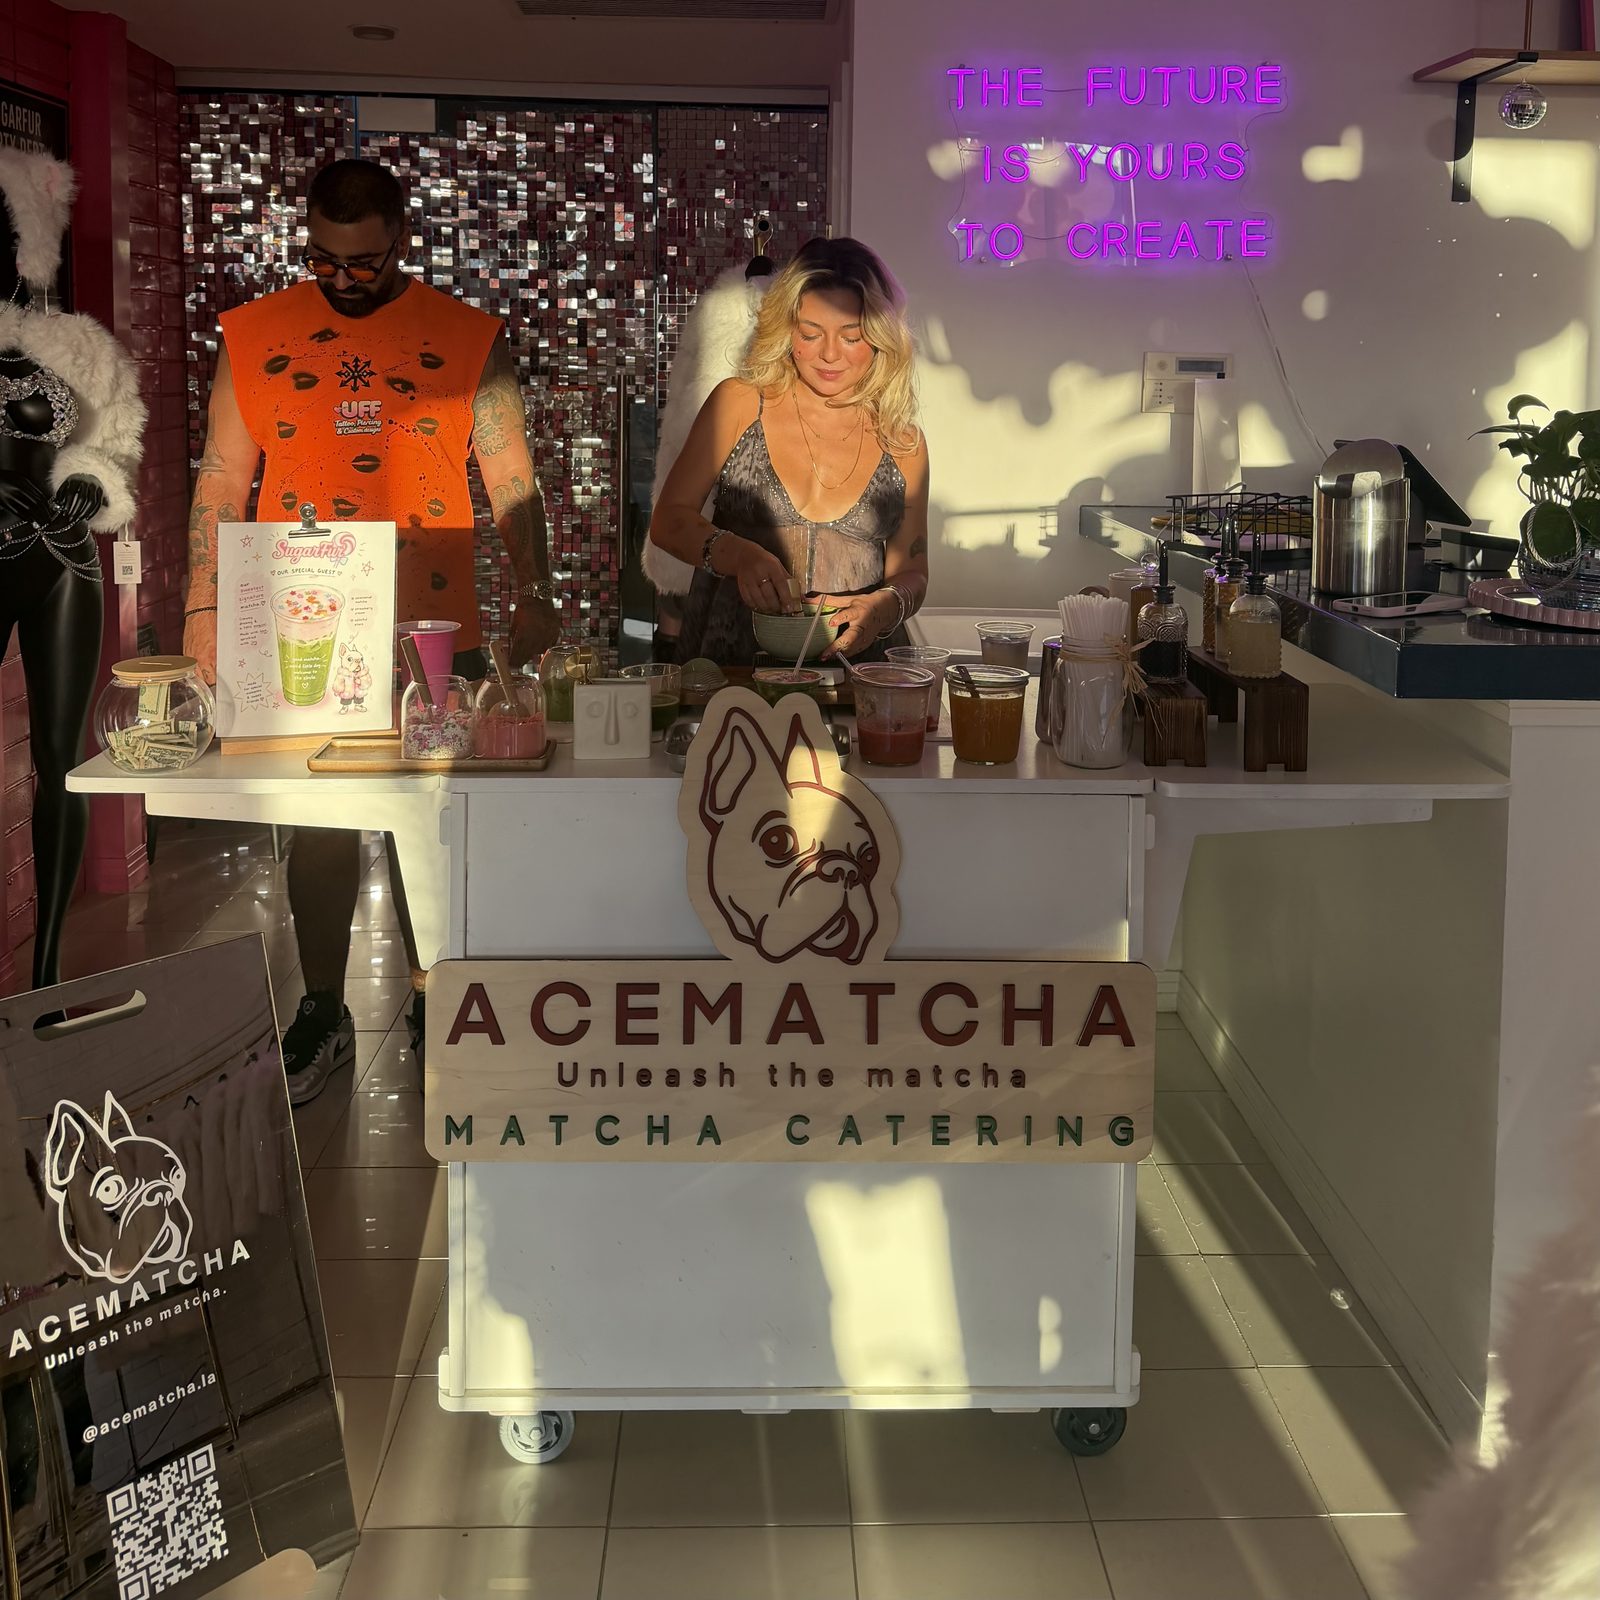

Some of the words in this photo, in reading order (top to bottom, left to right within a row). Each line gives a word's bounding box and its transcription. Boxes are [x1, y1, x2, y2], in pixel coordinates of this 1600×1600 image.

[946, 67, 1043, 110] THE
[1087, 65, 1282, 107] FUTURE
[983, 144, 1030, 183] IS
[1066, 142, 1246, 184] YOURS
[956, 222, 1025, 260] TO
[1066, 220, 1267, 260] CREATE
[341, 400, 382, 419] UFF
[277, 569, 289, 577] OUR
[291, 567, 315, 575] SPECIAL
[317, 568, 336, 576] GUEST
[445, 981, 1137, 1048] ACEMATCHA
[556, 1061, 736, 1088] Unleash
[768, 1062, 835, 1089] the
[867, 1063, 1028, 1089] matcha
[444, 1114, 722, 1147] MATCHA
[785, 1114, 1136, 1147] CATERING
[9, 1239, 252, 1358] ACEMATCHA
[44, 1329, 119, 1370] Unleash
[125, 1315, 153, 1336] the
[159, 1288, 228, 1320] matcha.
[82, 1370, 217, 1444] @acematcha.la
